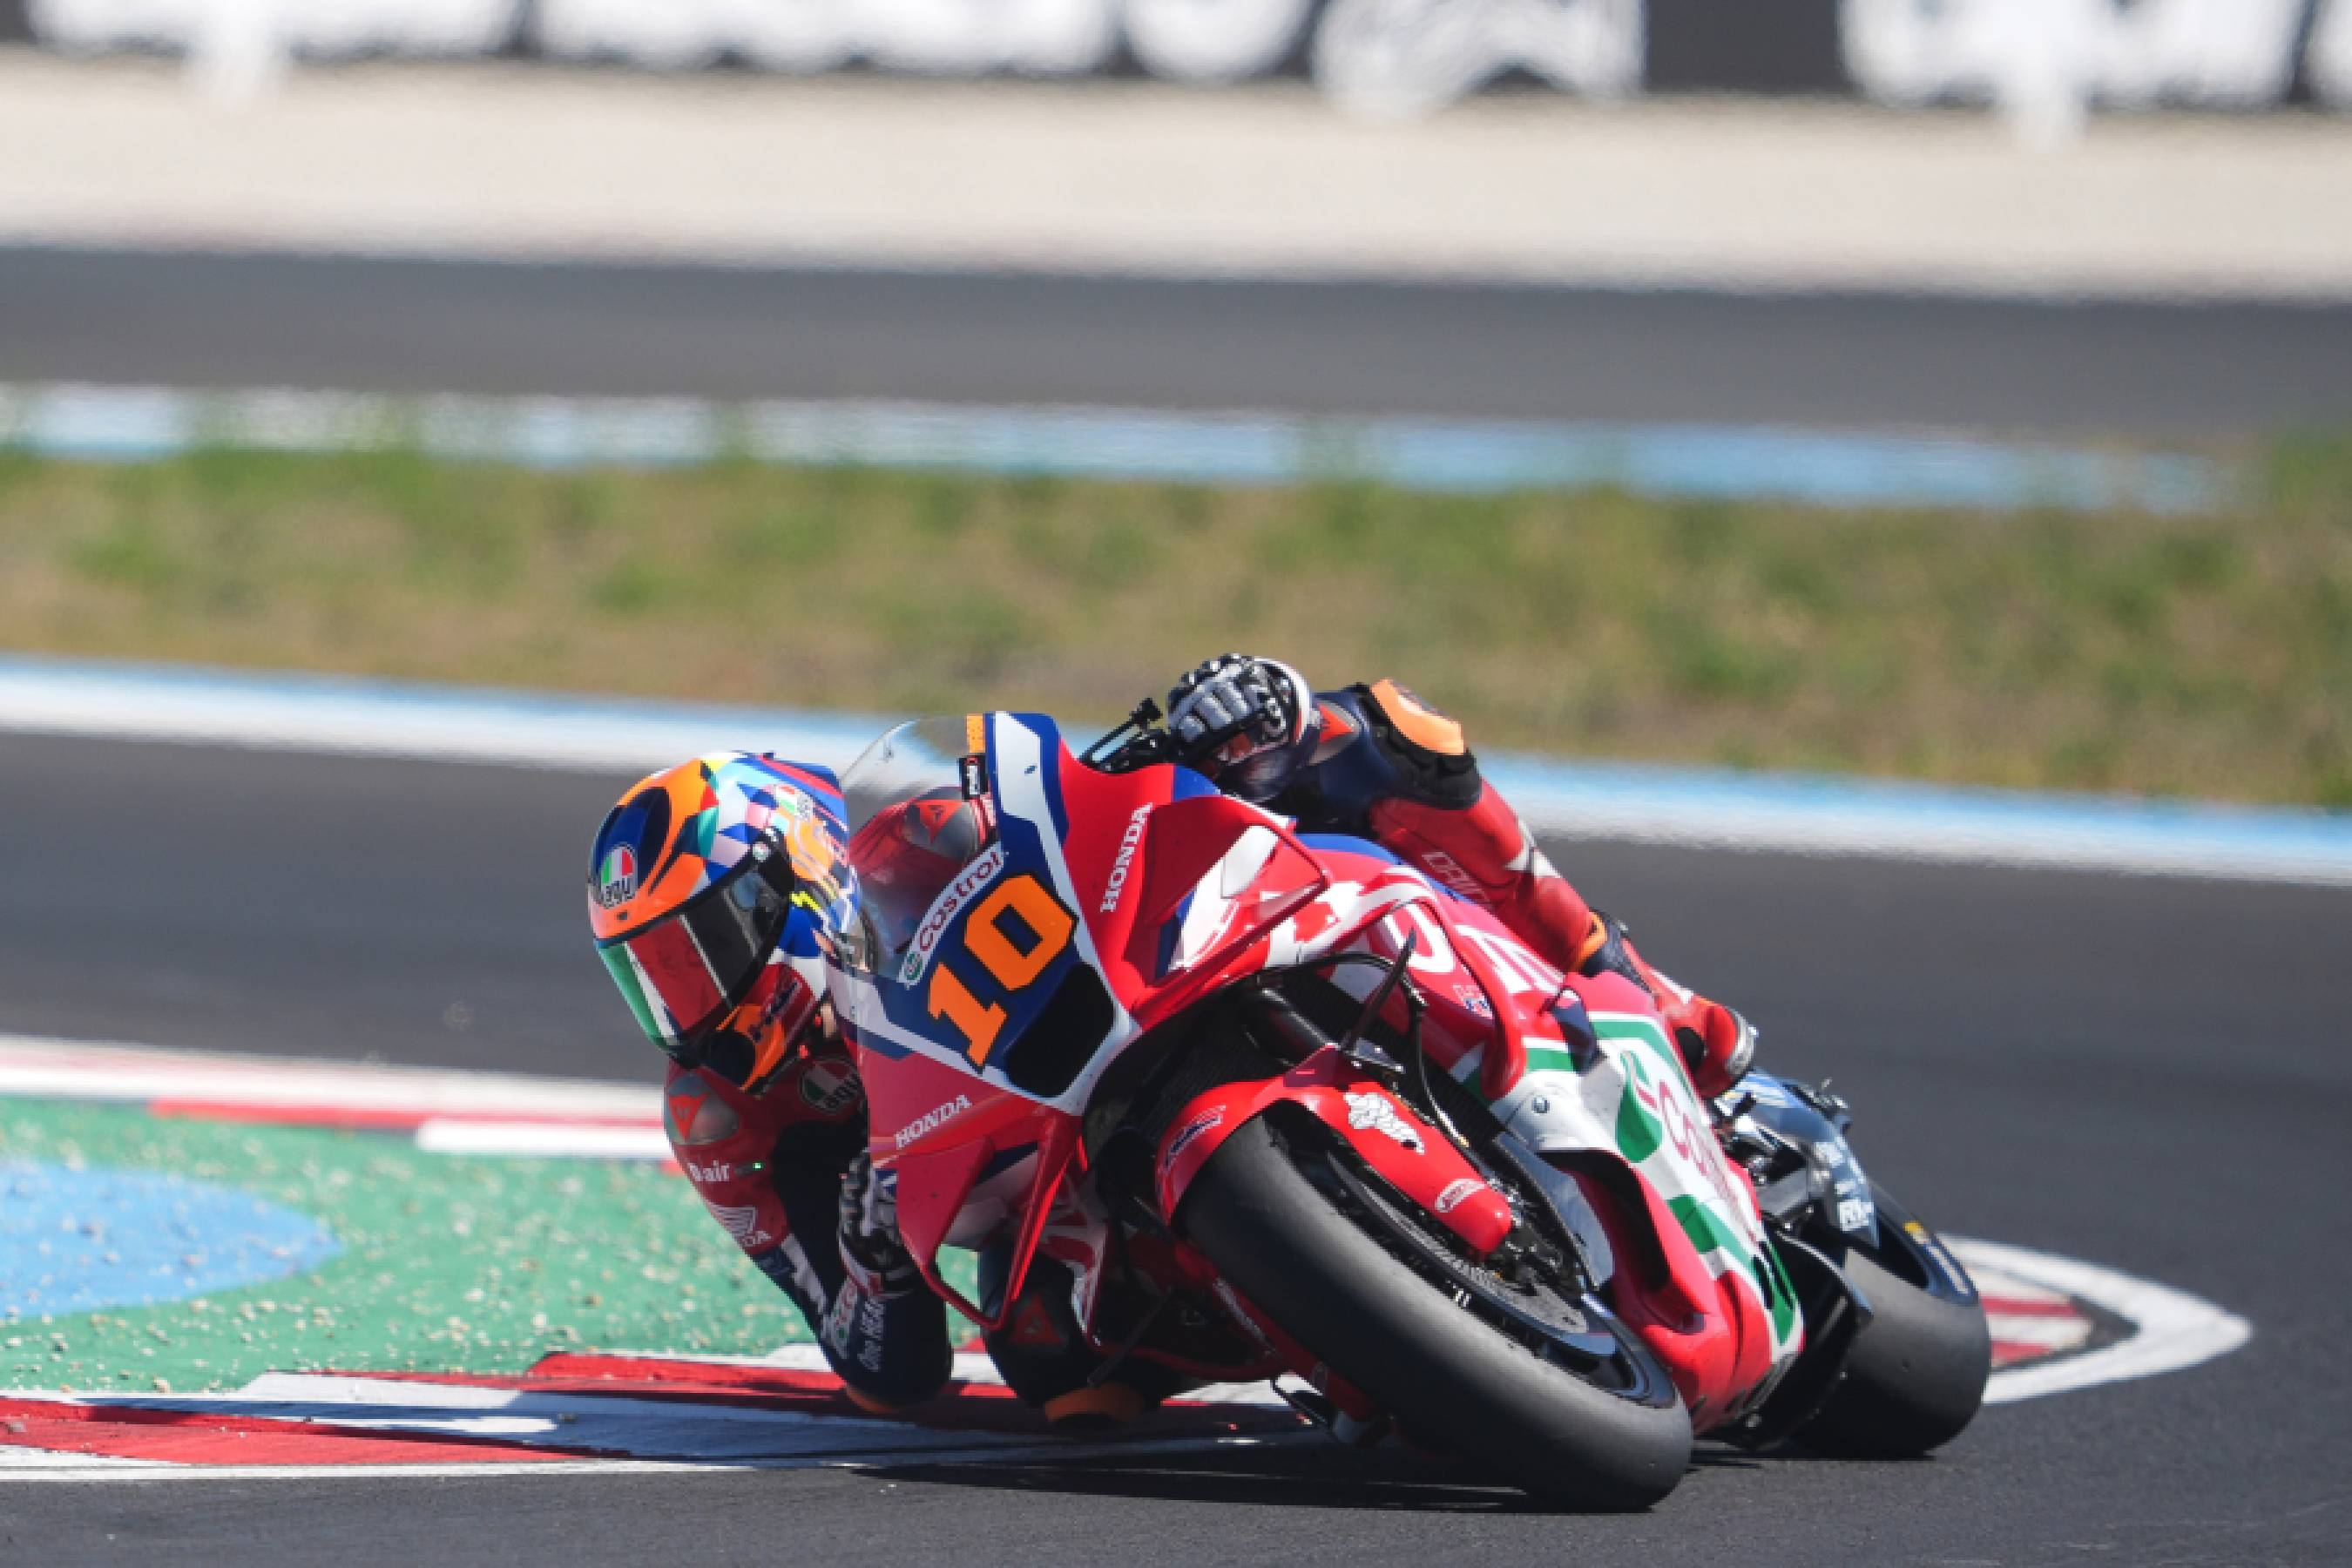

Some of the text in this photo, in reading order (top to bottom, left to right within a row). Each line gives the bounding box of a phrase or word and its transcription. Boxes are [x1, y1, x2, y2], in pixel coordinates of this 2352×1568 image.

[919, 851, 1002, 952] Castrol
[1100, 802, 1153, 914] HONDA
[927, 873, 1078, 1073] 10
[894, 1094, 973, 1150] HONDA
